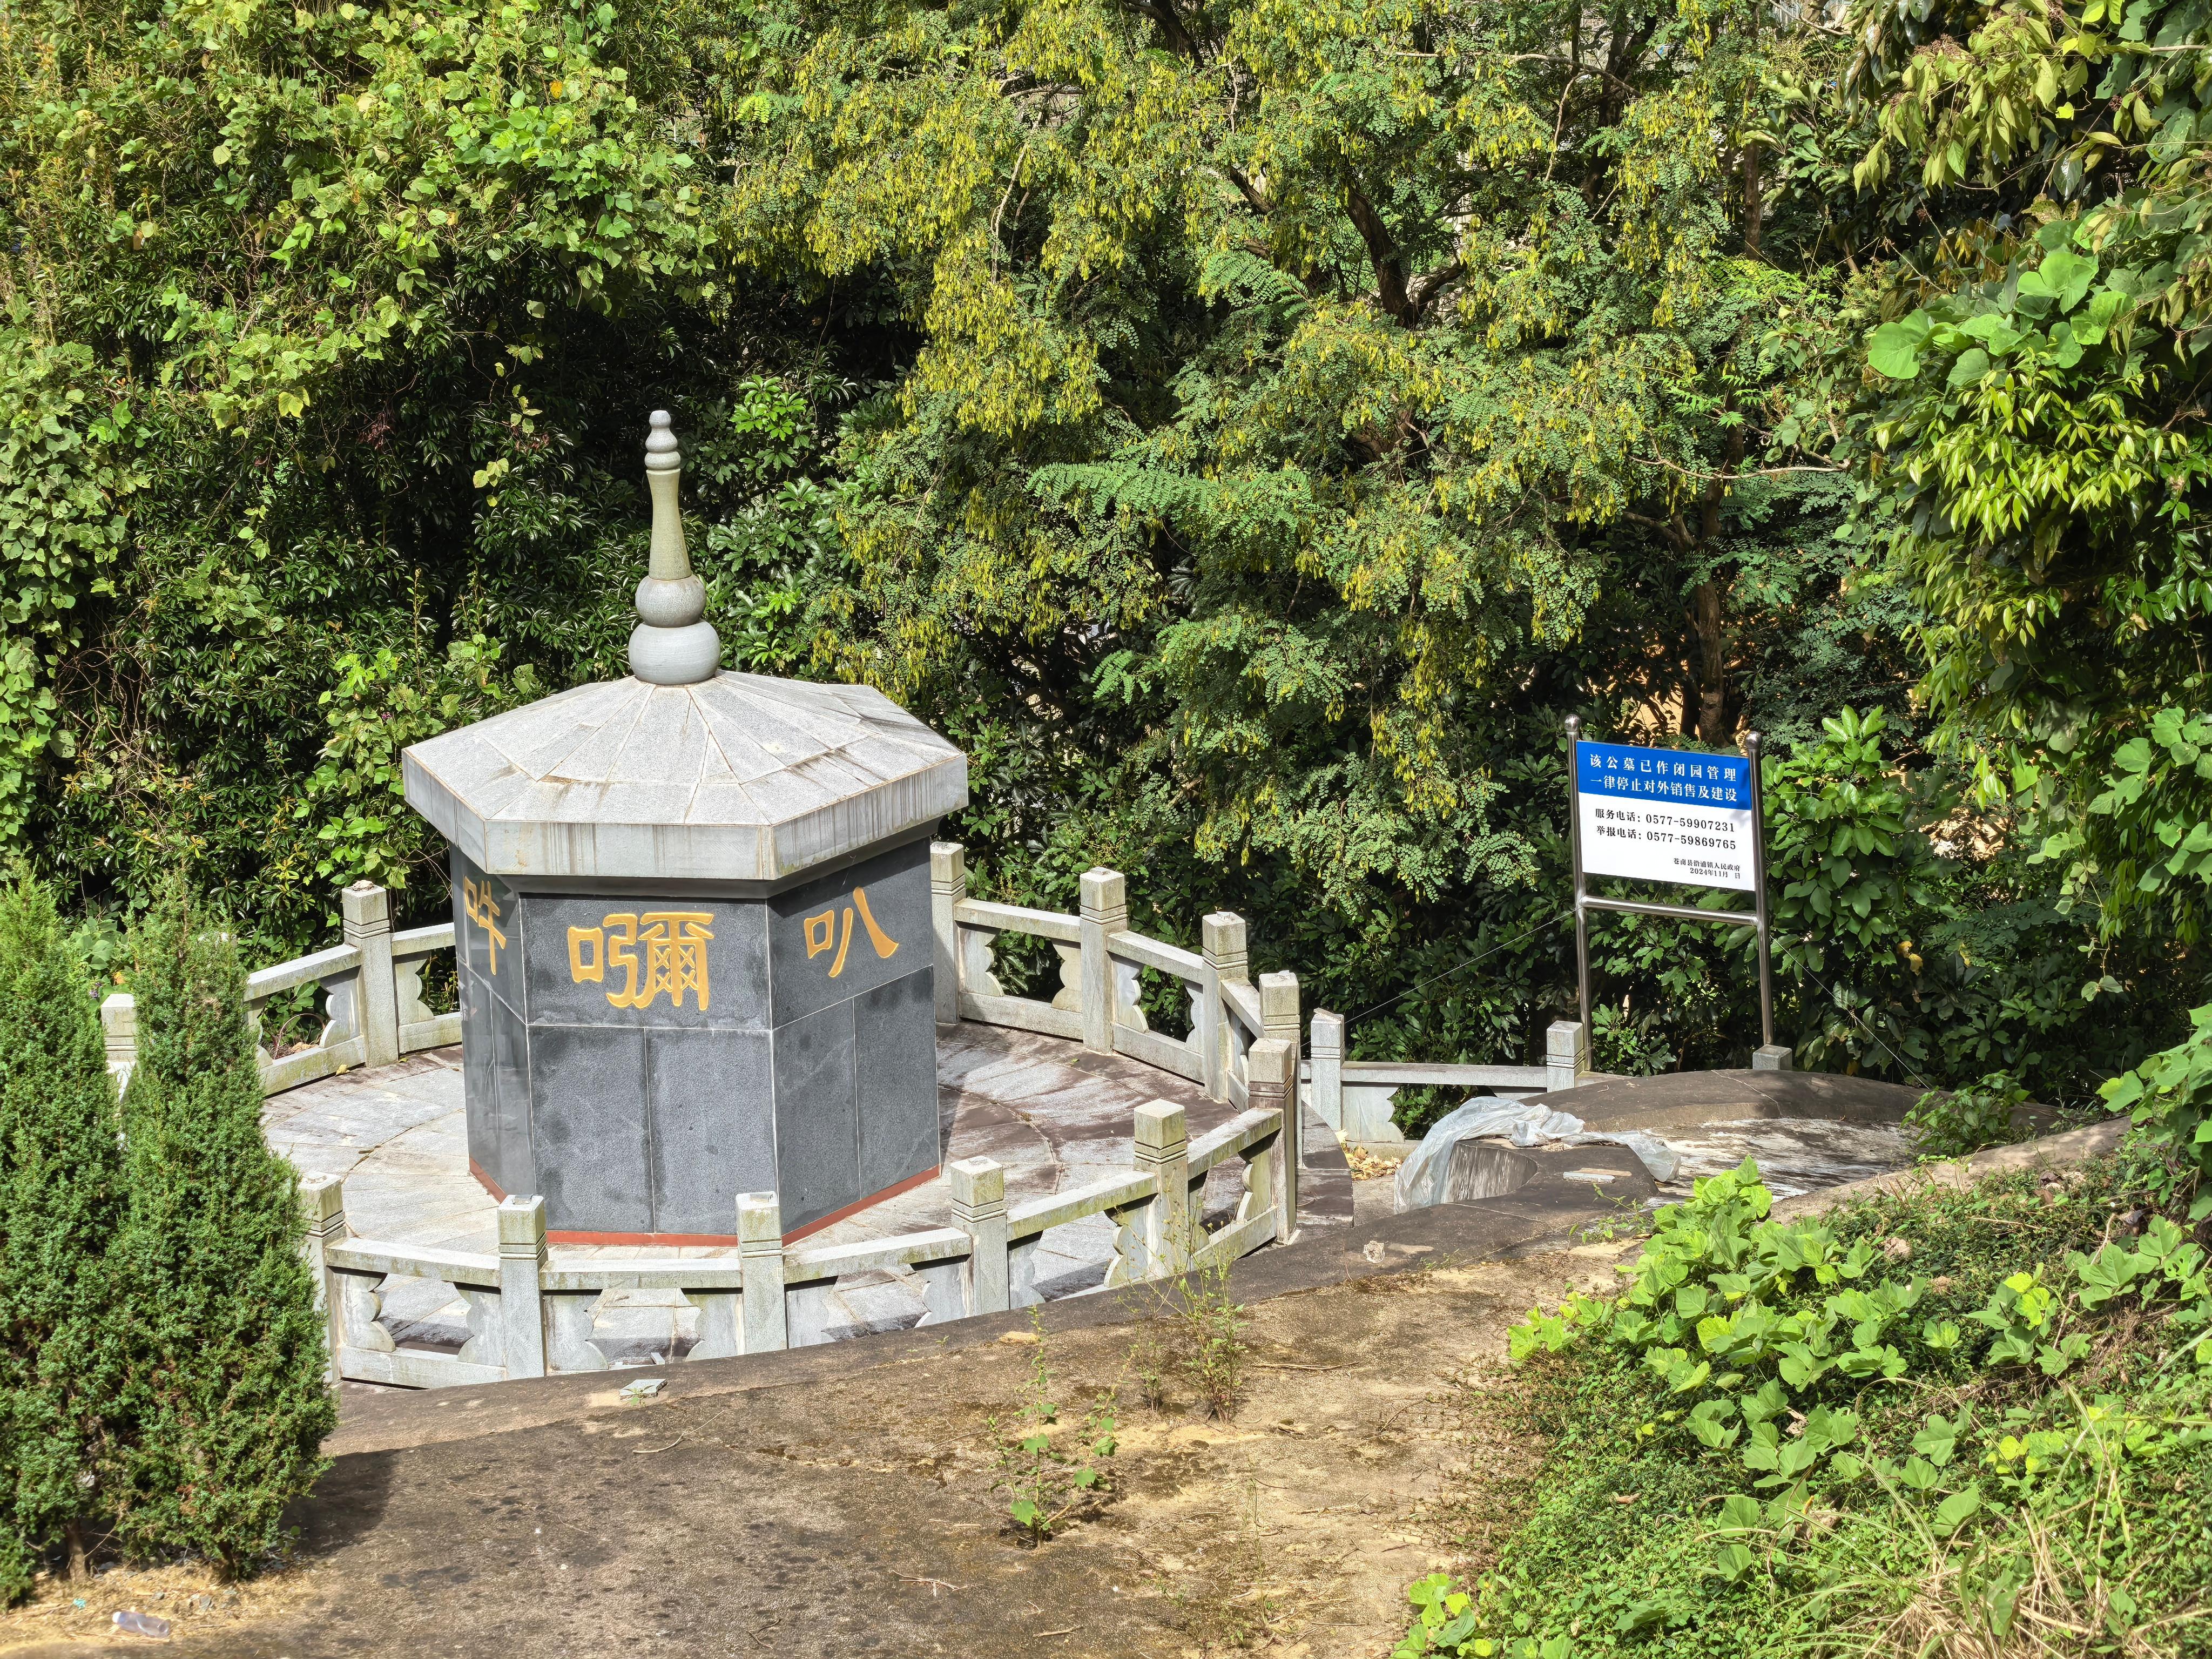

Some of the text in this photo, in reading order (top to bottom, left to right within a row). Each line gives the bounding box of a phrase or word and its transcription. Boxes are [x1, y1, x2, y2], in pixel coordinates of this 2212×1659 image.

[1590, 754, 1736, 781] 该公墓已作闭园管理
[1591, 775, 1737, 802] 一律停止对外销售及建设
[1674, 858, 1740, 871] 苍南县沿浦镇人民政府
[1690, 867, 1728, 878] 2024年11月
[463, 876, 507, 975] 吽
[804, 887, 899, 978] 叭
